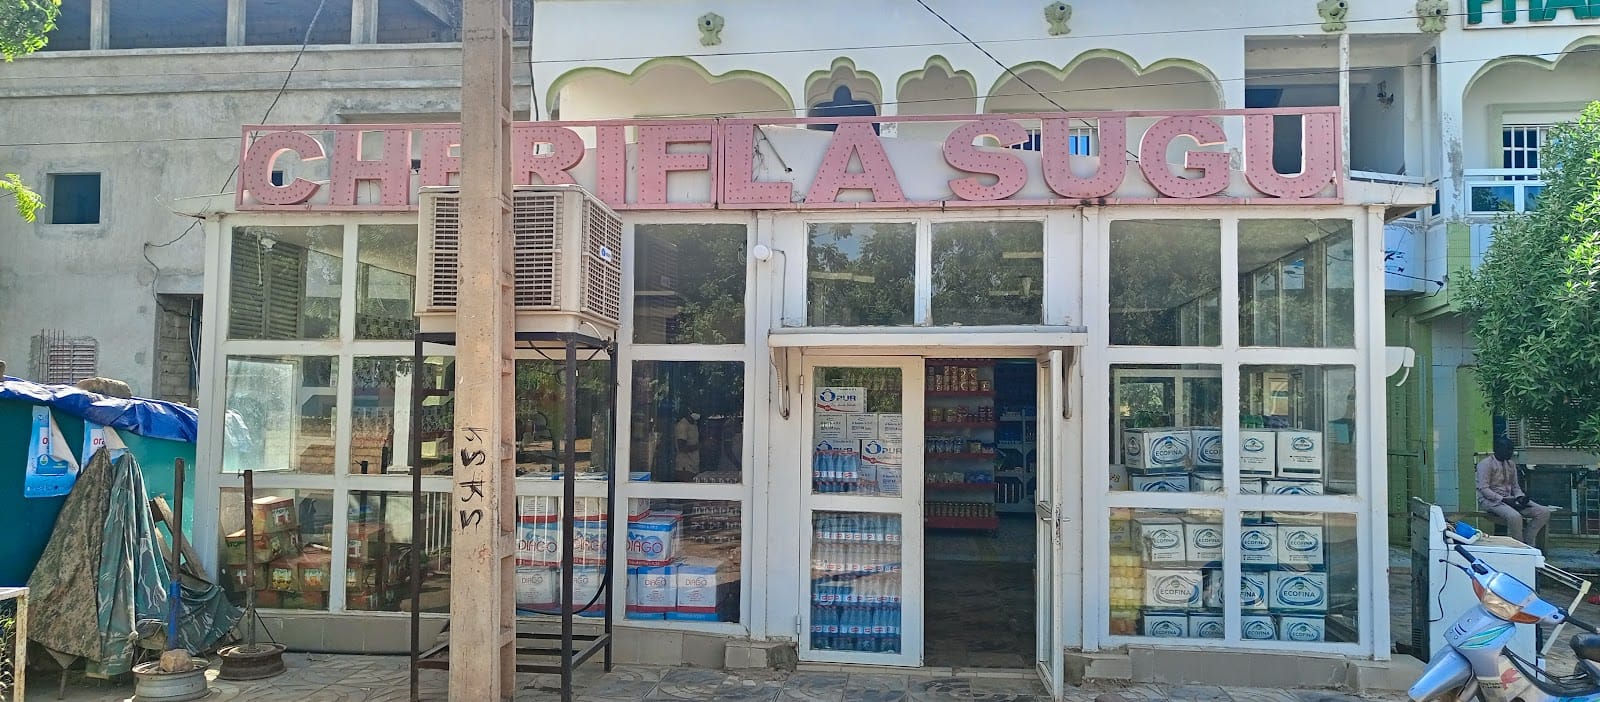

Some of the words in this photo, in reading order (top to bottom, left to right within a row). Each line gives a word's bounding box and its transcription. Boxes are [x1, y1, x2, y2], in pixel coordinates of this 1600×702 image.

[942, 112, 1337, 202] SUGU
[1160, 588, 1192, 597] ECOFINA
[1283, 590, 1316, 599] ECOFINA
